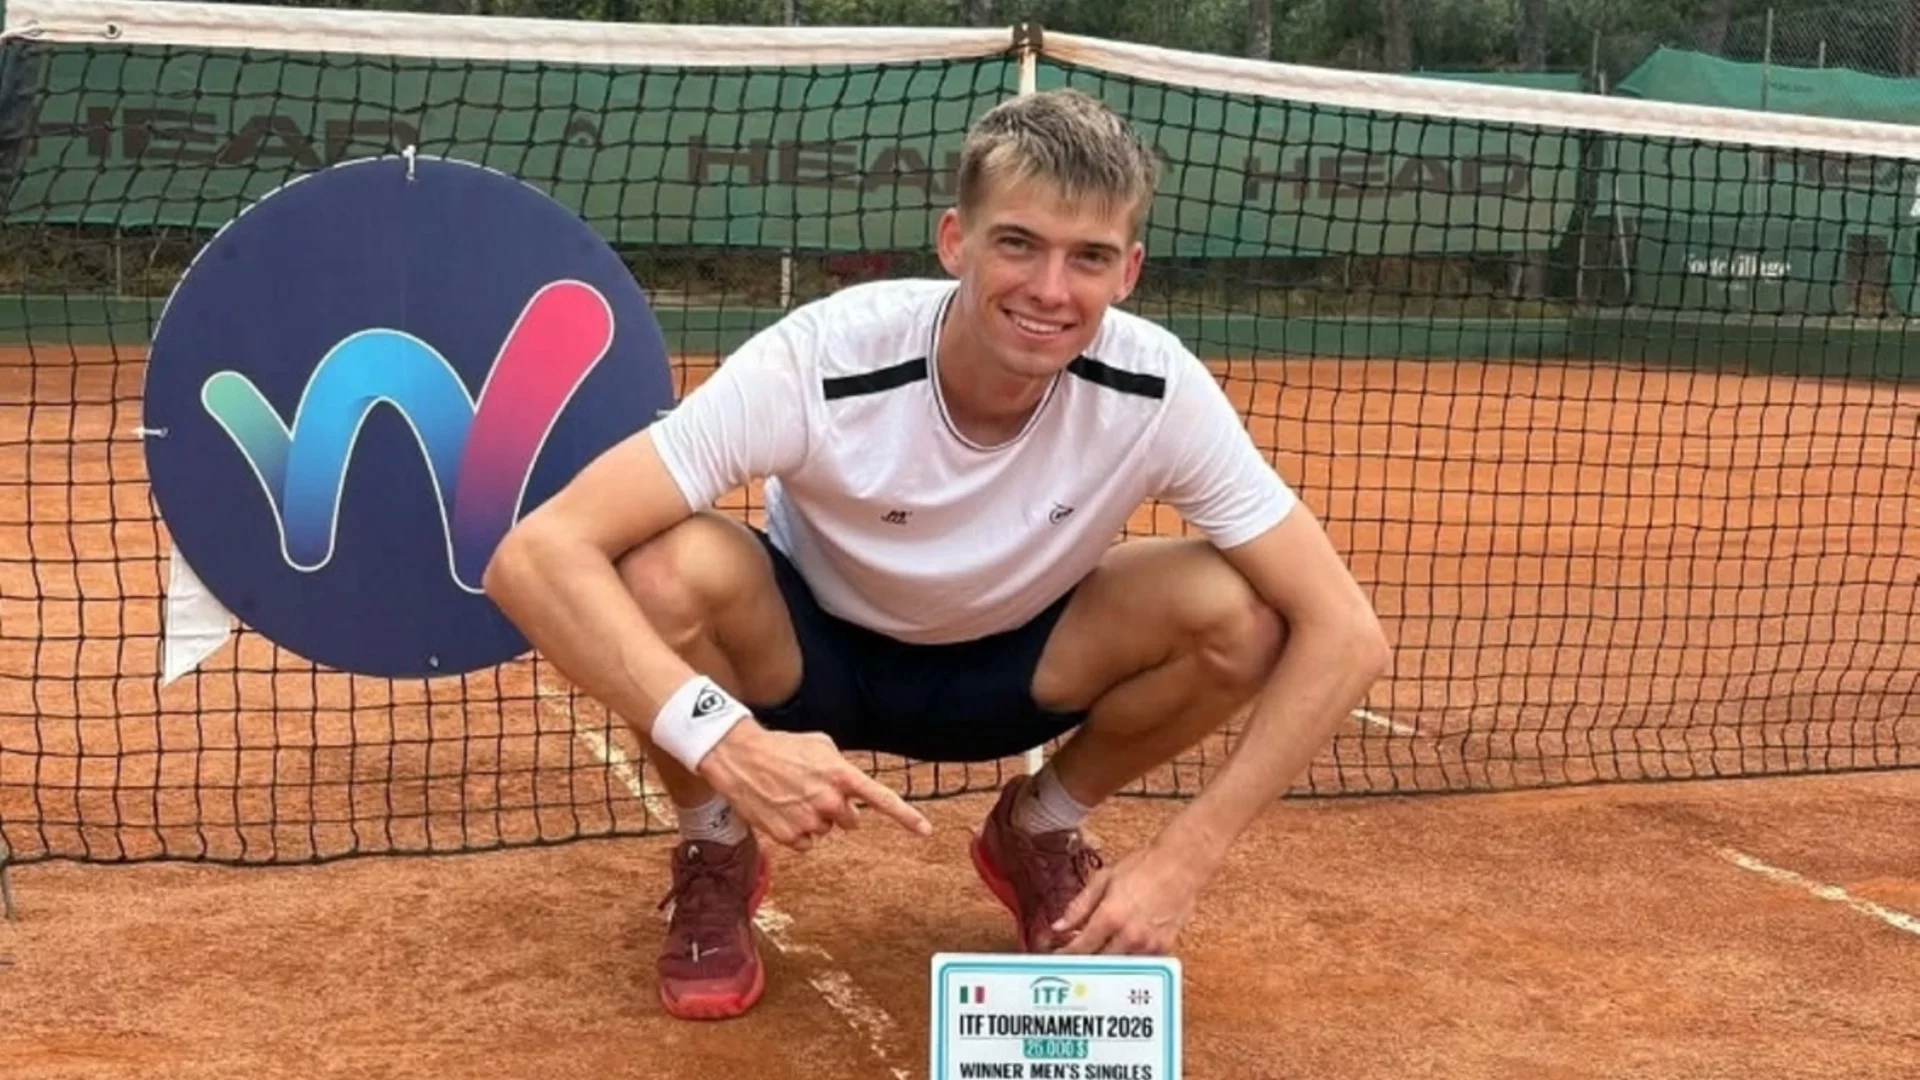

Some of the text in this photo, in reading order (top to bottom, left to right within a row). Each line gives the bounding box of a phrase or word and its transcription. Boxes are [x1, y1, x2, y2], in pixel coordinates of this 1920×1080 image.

[688, 134, 961, 196] HEA
[1243, 153, 1526, 200] HEAD
[1033, 986, 1070, 1004] ITF
[960, 1014, 1153, 1038] ITF TOURNAMENT 2026
[960, 1062, 1153, 1080] WINNER MEN'S SINGLES
